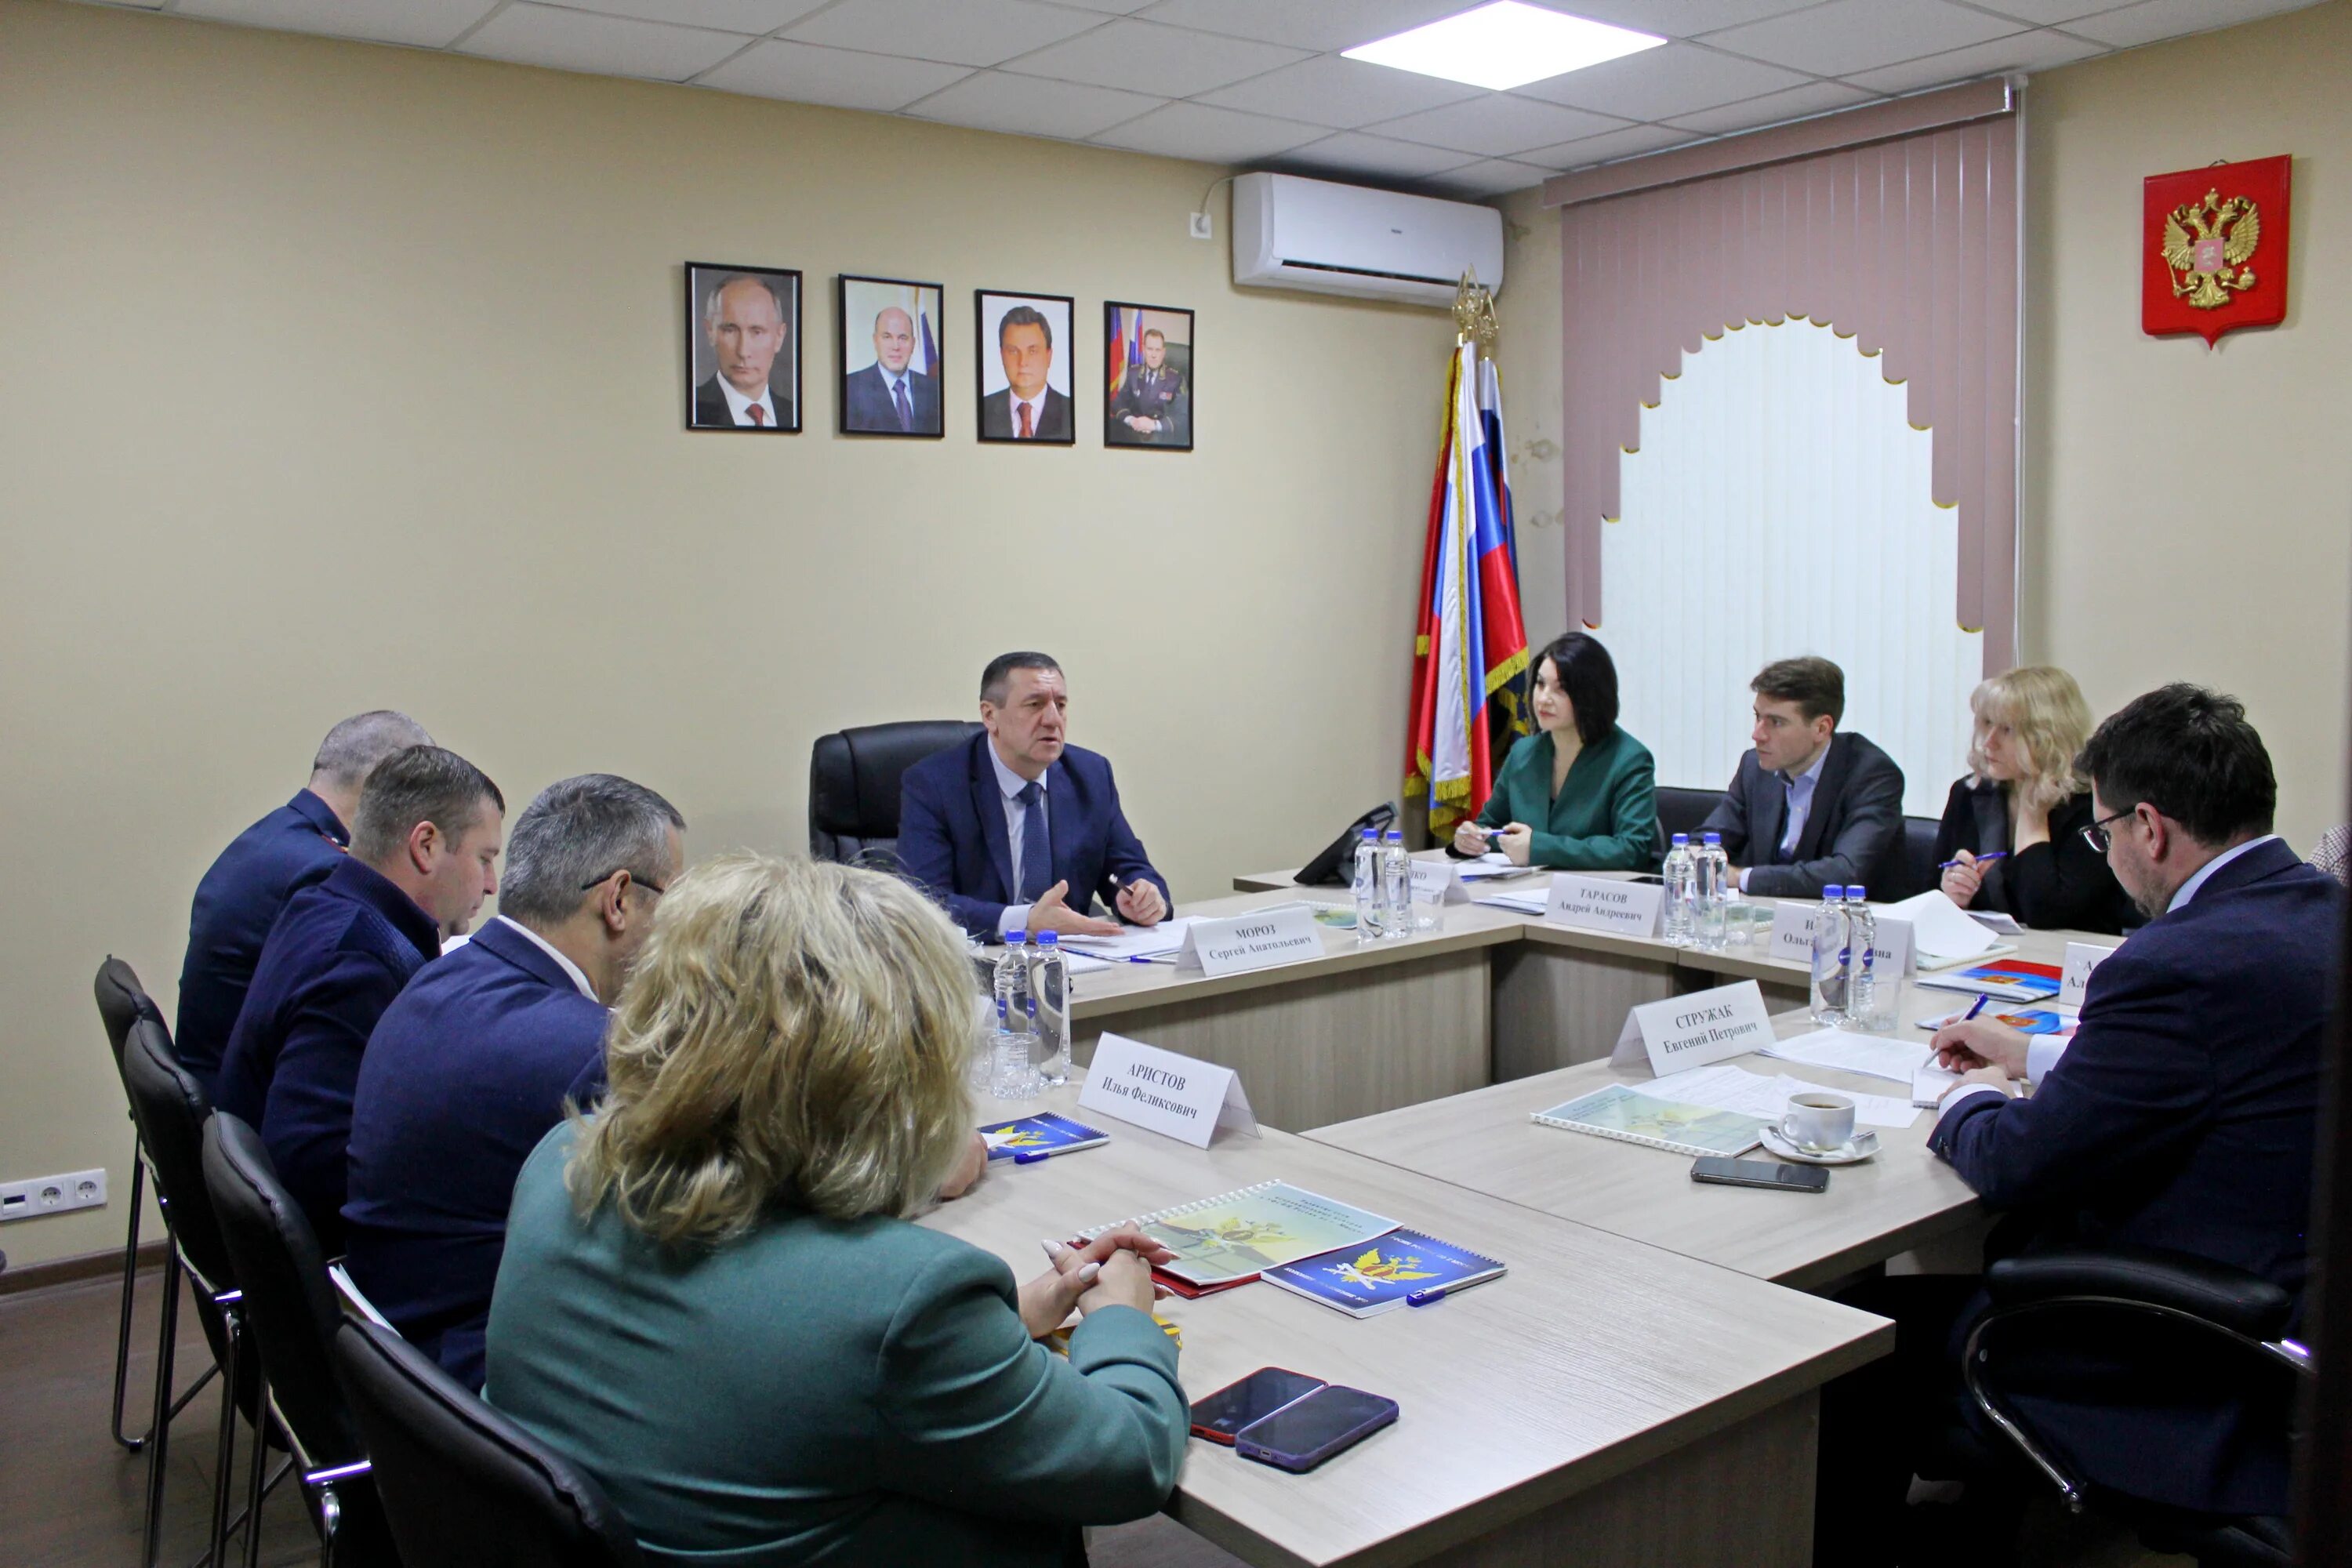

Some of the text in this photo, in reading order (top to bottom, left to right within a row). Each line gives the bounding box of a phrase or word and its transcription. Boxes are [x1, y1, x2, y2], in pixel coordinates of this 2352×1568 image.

[1581, 888, 1628, 903] ТАРАСОВ
[1558, 901, 1642, 921] Андрей Андреевич
[1236, 924, 1276, 940] МОРОЗ
[1209, 936, 1312, 960] Сергей Анатольевич
[1675, 1004, 1733, 1029] СТРУЖАК
[1663, 1022, 1758, 1054] Евгений Петрович
[1127, 1063, 1186, 1091] АРИСТОВ
[1102, 1076, 1198, 1119] Илья Феликсович
